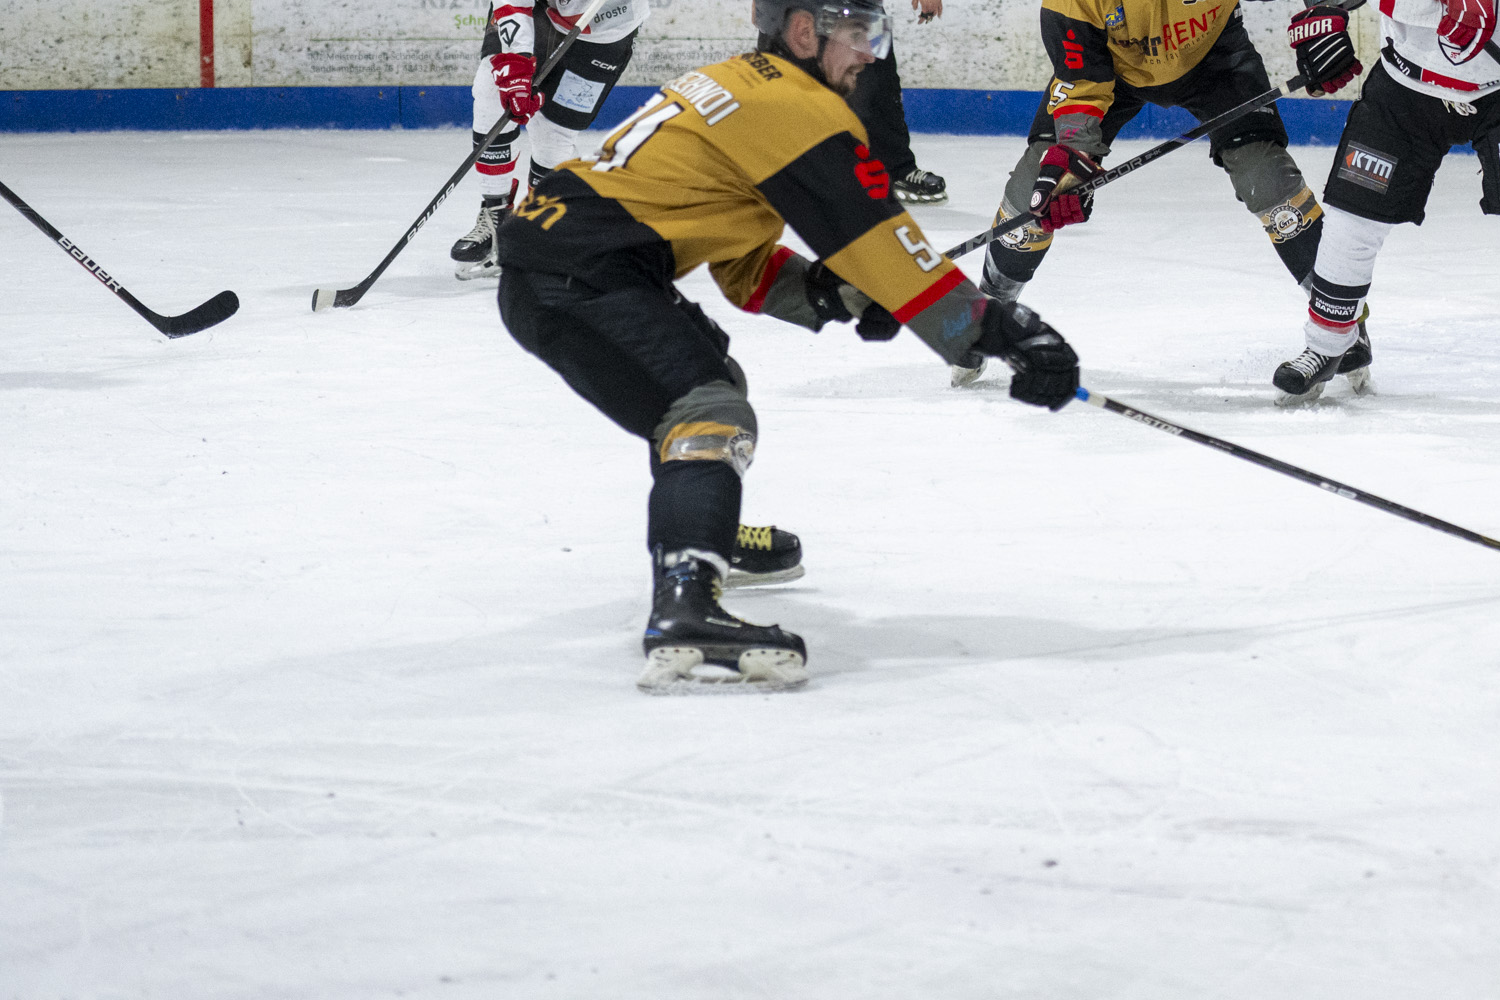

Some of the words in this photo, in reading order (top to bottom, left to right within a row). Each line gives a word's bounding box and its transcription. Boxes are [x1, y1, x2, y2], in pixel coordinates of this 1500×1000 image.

[593, 4, 629, 24] droste
[1162, 4, 1222, 52] RENT
[591, 59, 618, 71] CCM
[1048, 81, 1076, 107] 5
[1351, 149, 1393, 180] KTM
[1314, 301, 1355, 316] BANNAT
[1123, 408, 1184, 436] EASTON
